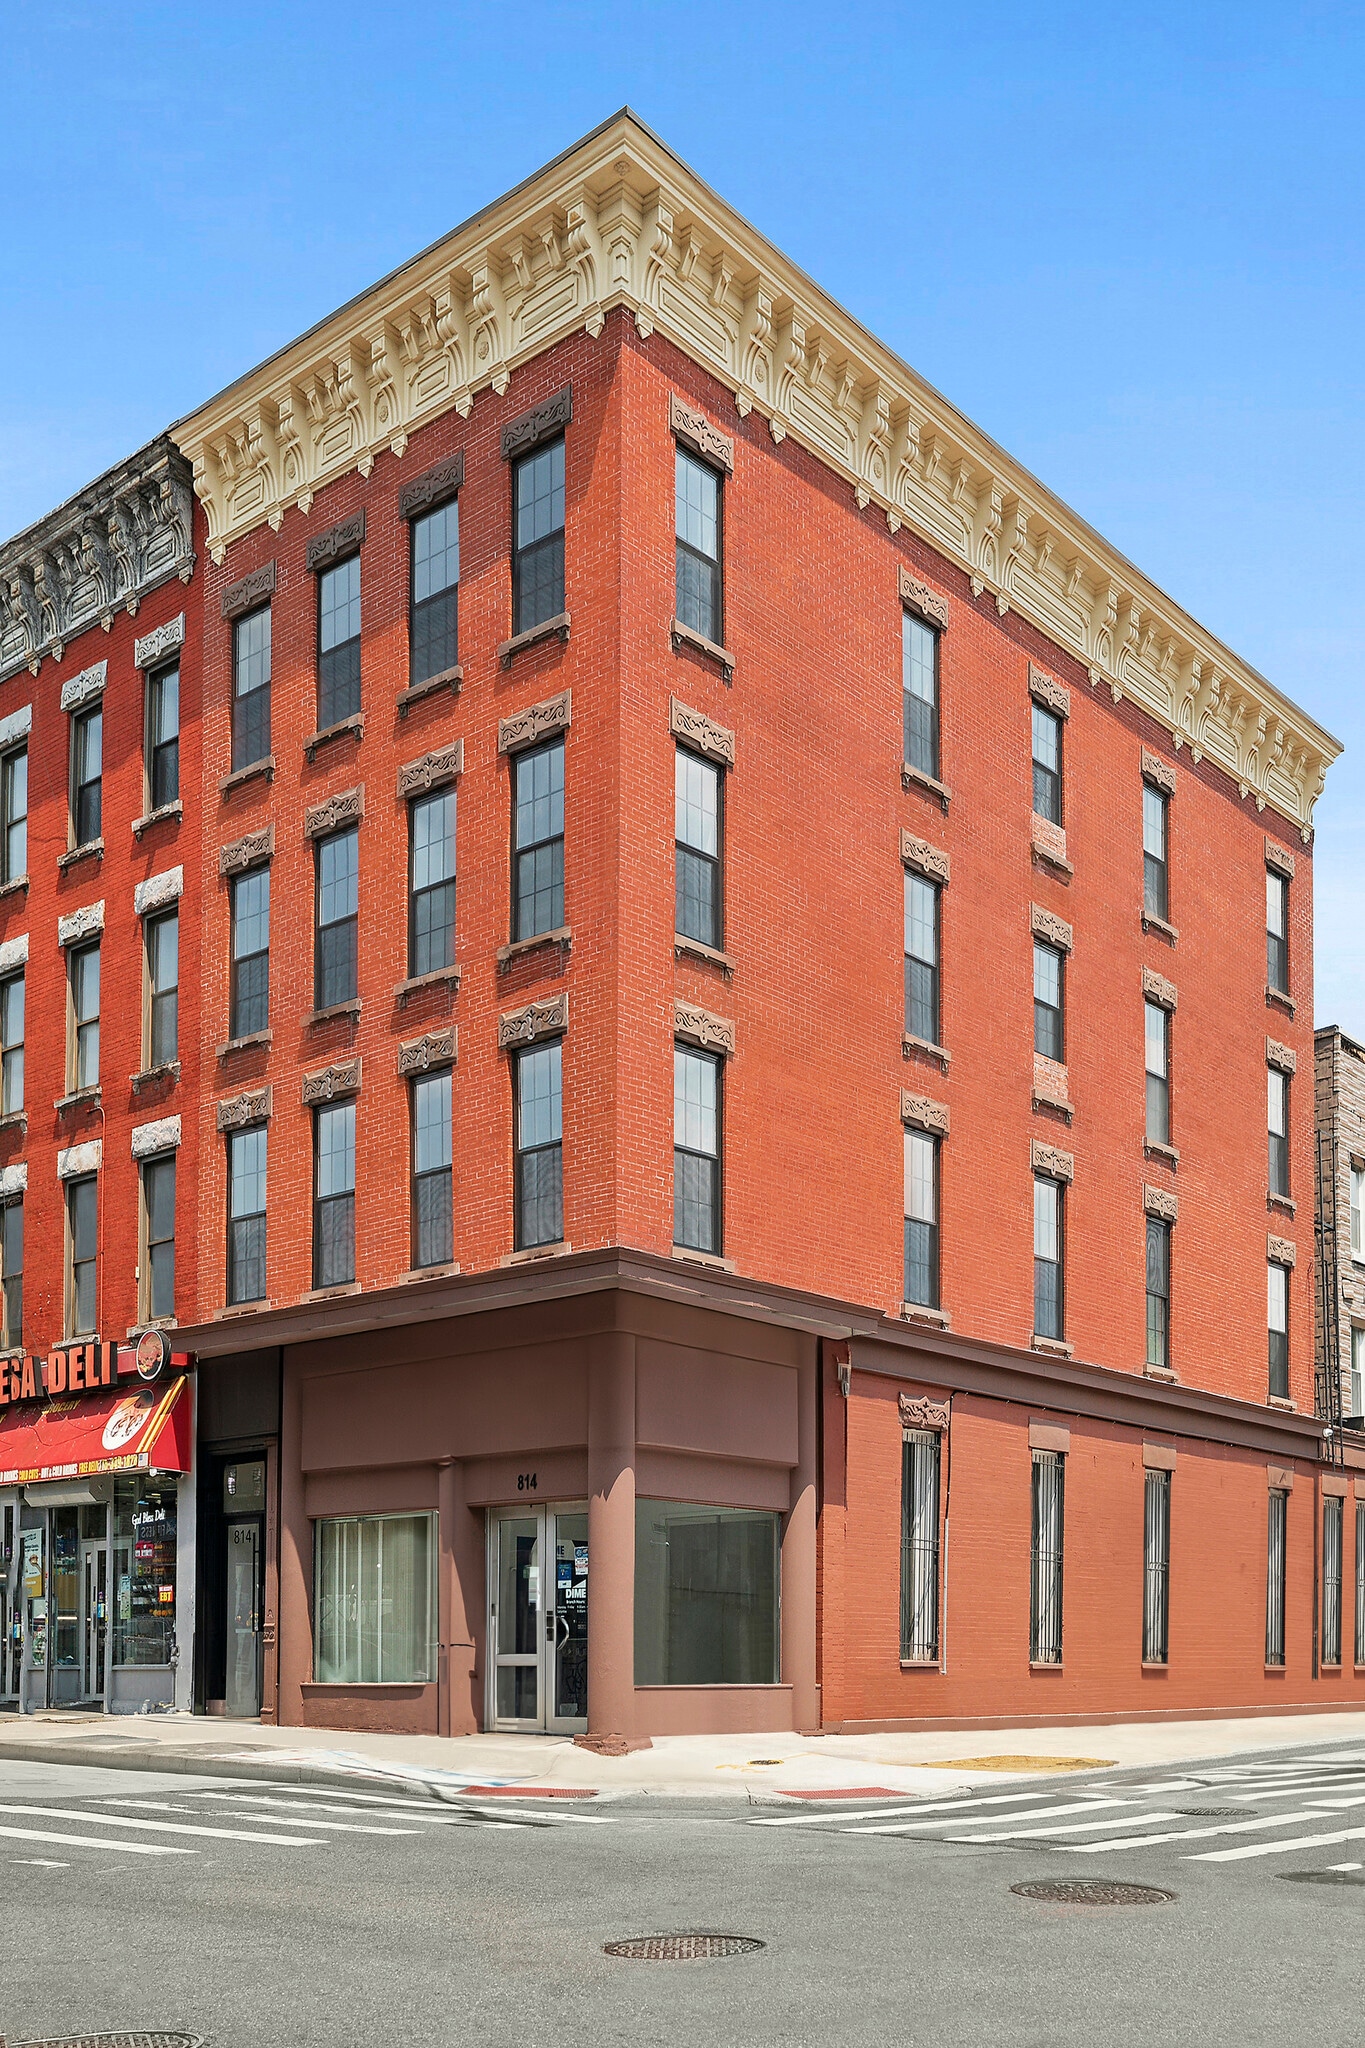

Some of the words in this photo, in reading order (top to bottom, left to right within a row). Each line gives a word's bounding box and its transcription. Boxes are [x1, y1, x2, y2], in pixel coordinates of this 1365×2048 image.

[47, 1341, 111, 1395] DELI
[517, 1473, 538, 1491] 814
[142, 1511, 155, 1524] Bless
[155, 1508, 166, 1521] Deli
[233, 1529, 251, 1544] 814
[160, 1591, 172, 1602] EBT
[565, 1588, 587, 1599] DIME
